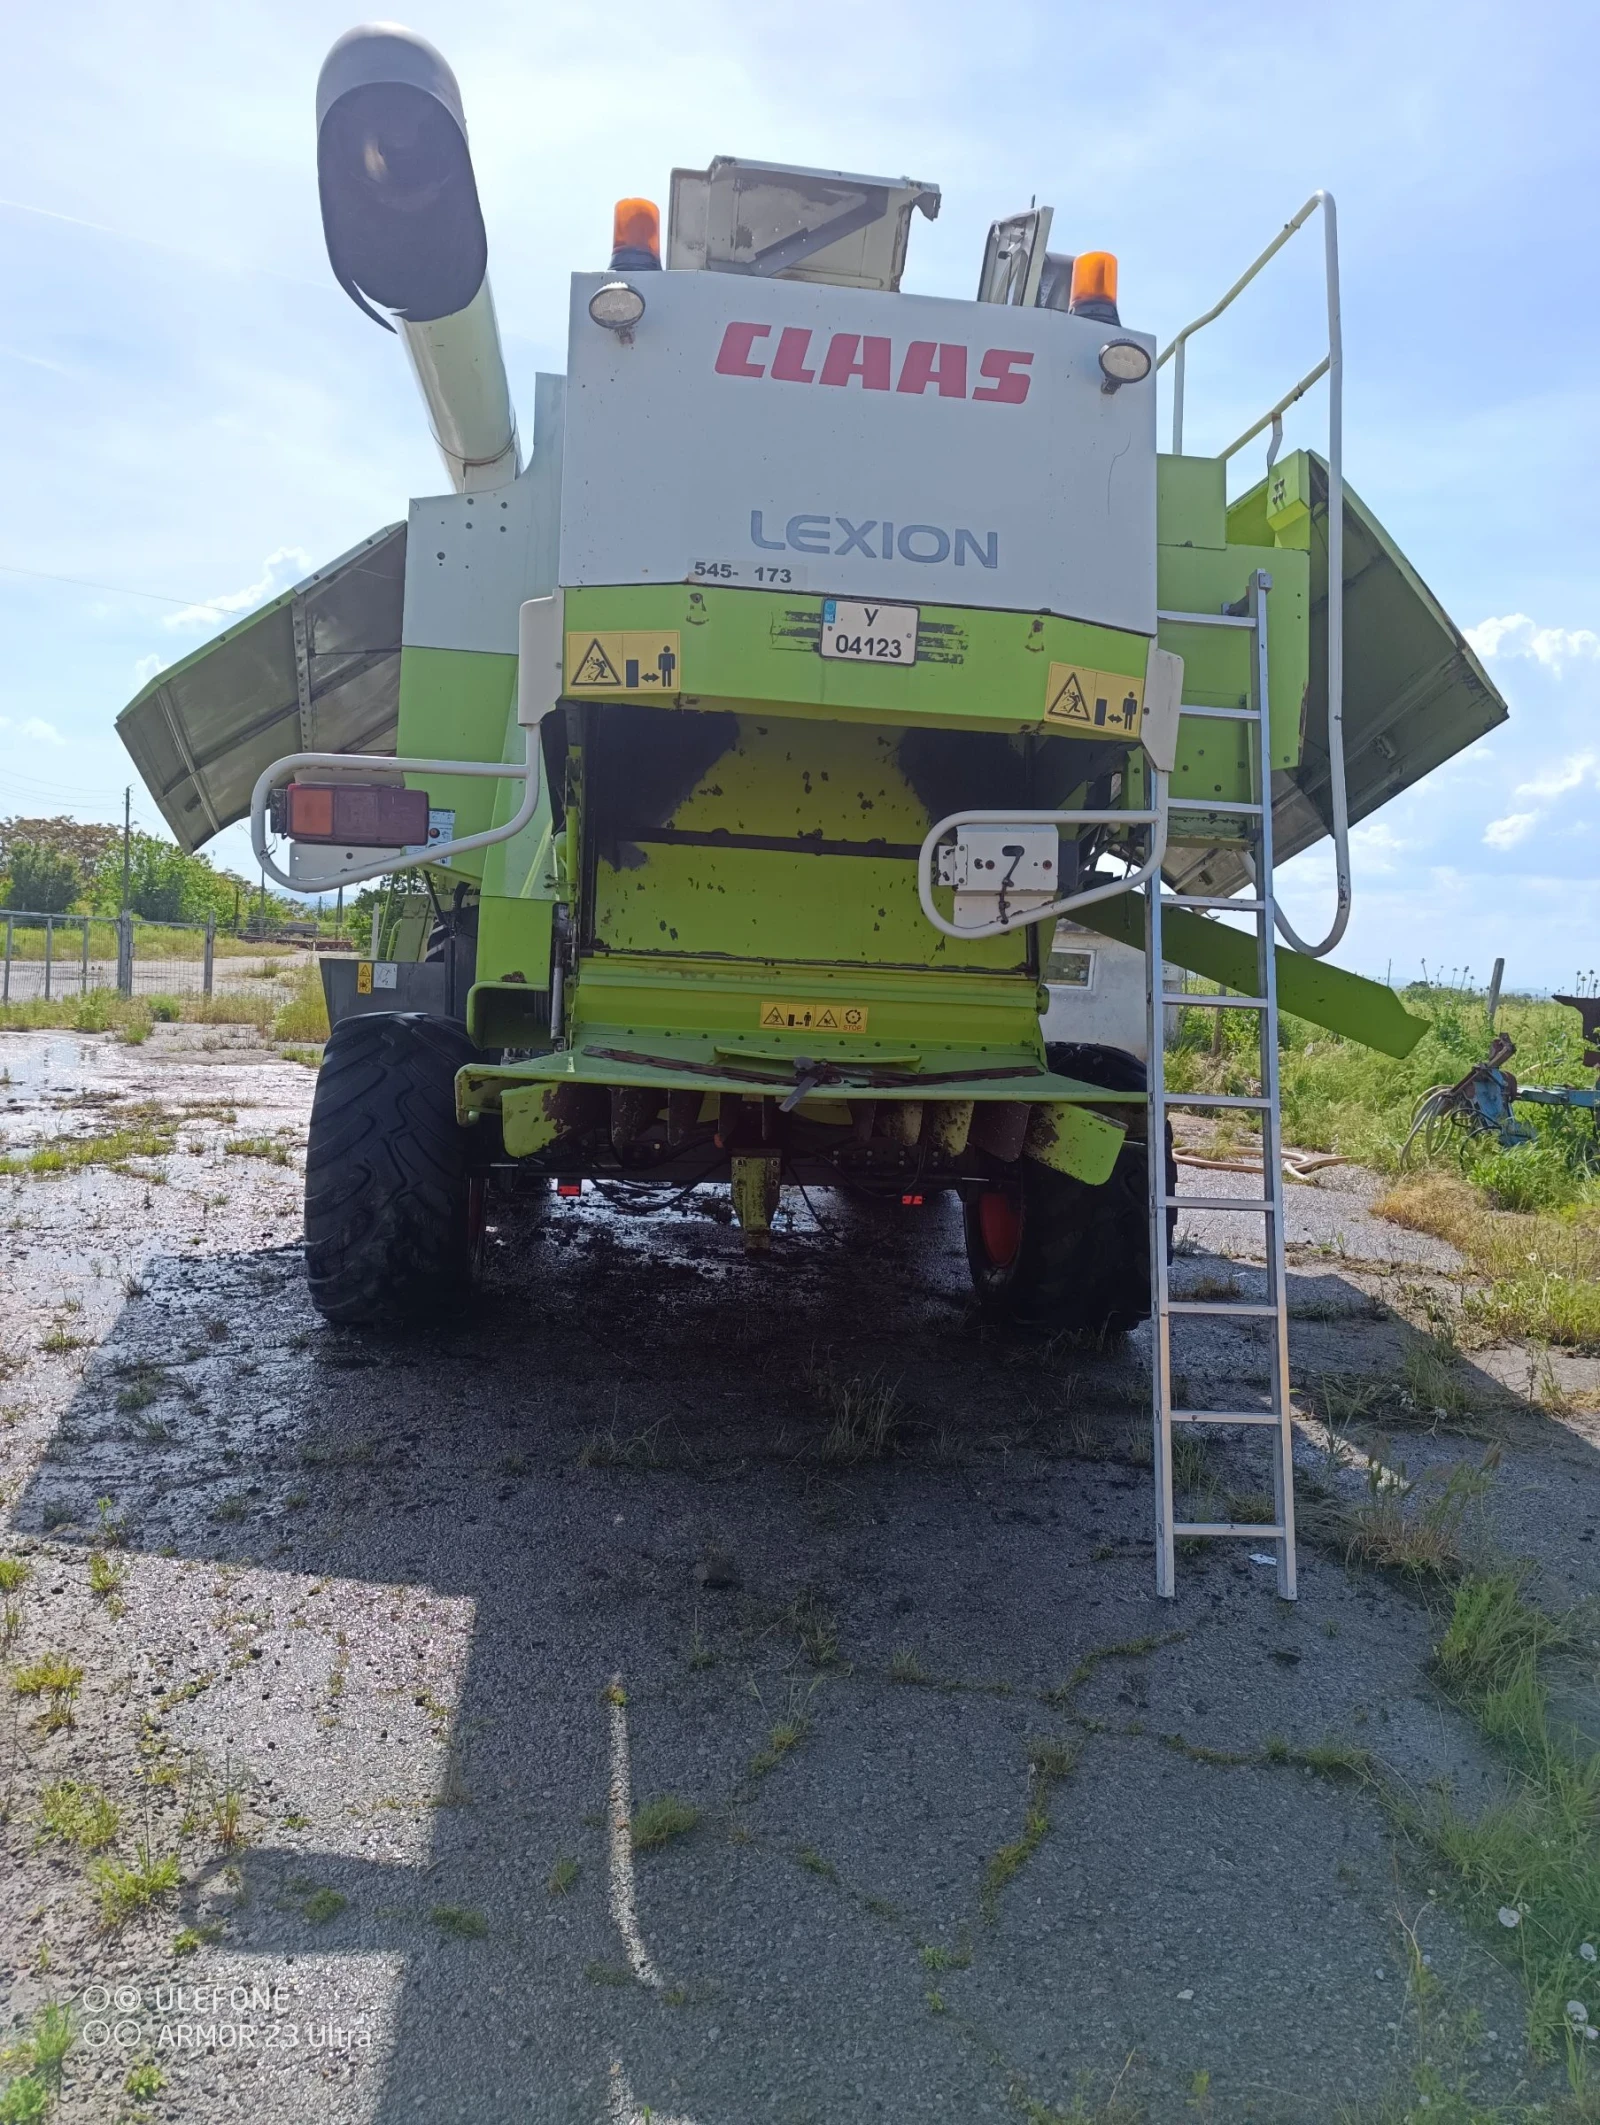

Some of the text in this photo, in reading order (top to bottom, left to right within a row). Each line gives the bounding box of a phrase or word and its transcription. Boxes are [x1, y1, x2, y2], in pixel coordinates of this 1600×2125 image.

[714, 321, 1035, 405] CLAAS
[750, 510, 998, 569] LEXION
[694, 561, 792, 584] 545- 173
[835, 634, 902, 659] 04123
